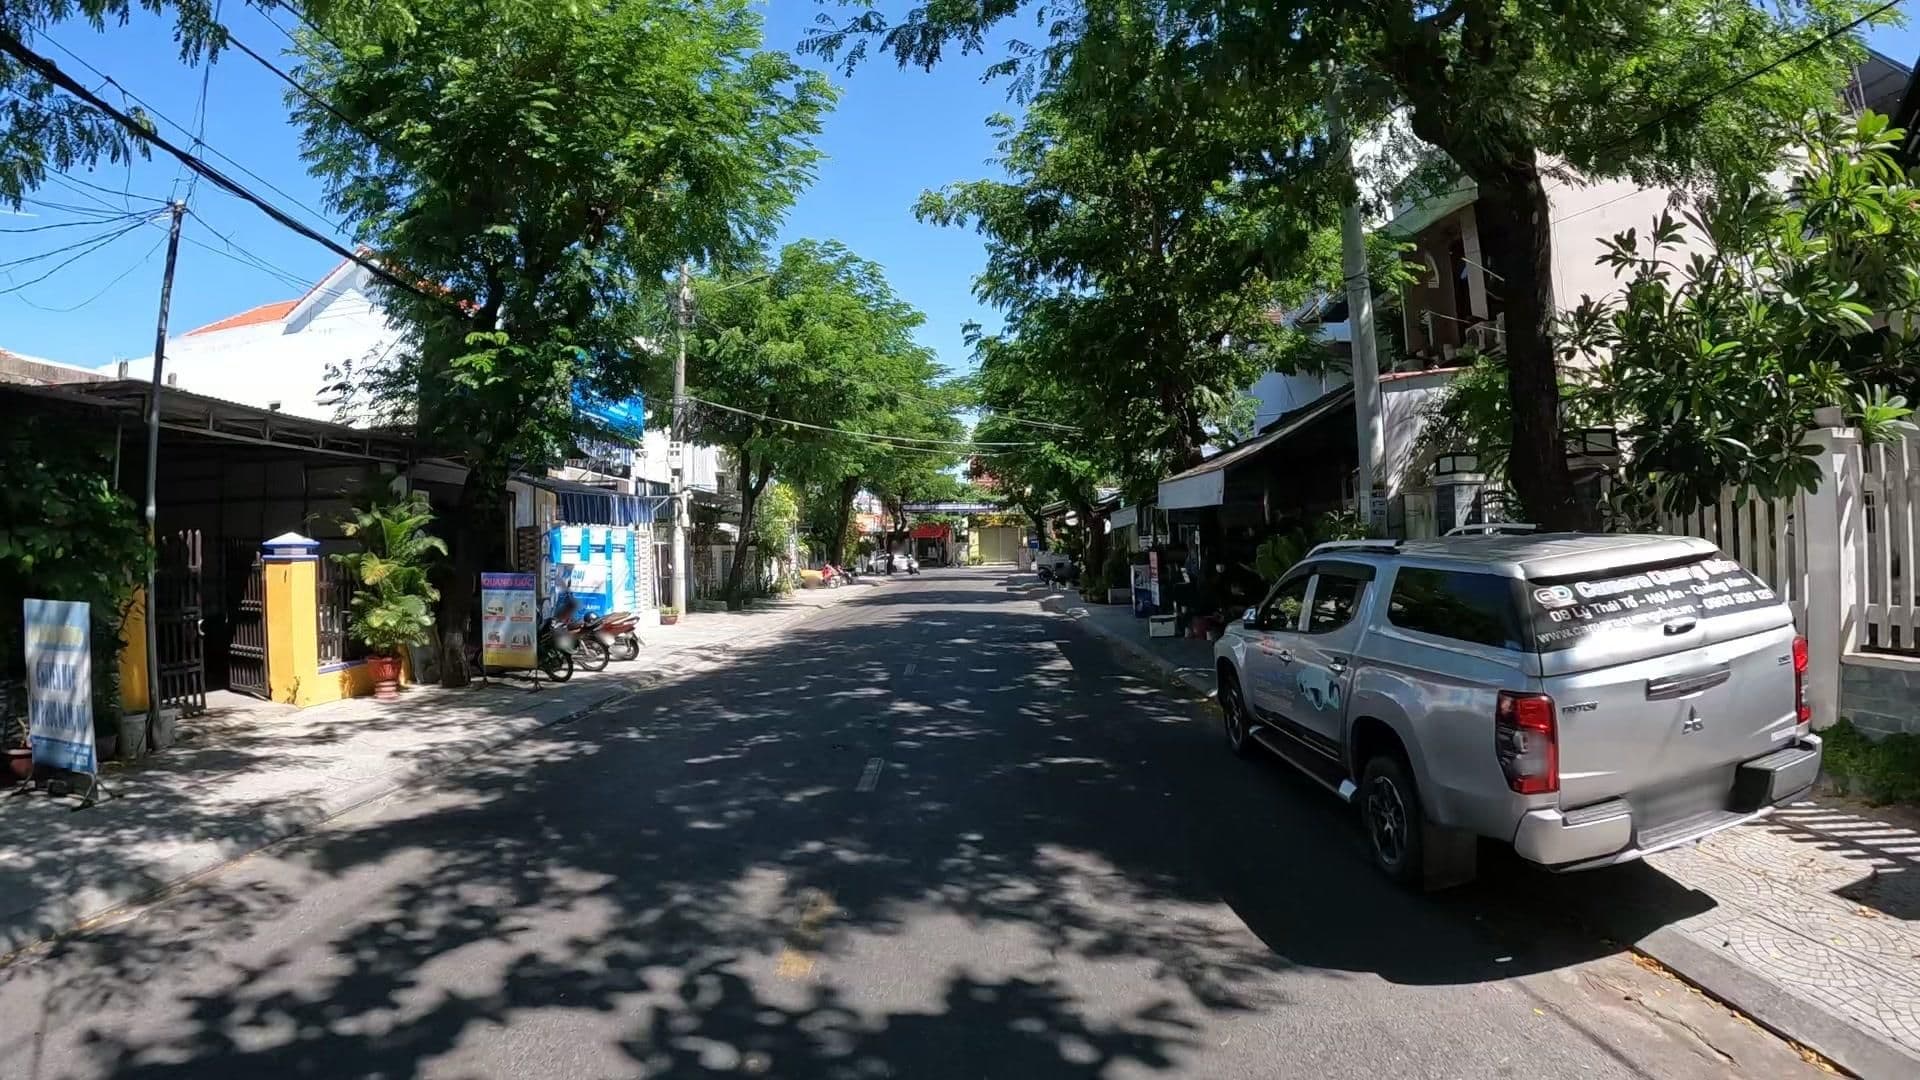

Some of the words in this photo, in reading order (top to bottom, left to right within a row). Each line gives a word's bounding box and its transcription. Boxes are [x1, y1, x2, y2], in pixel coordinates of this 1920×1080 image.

[1577, 577, 1653, 598] Camera
[1646, 566, 1710, 586] Quang
[1666, 589, 1686, 601] An
